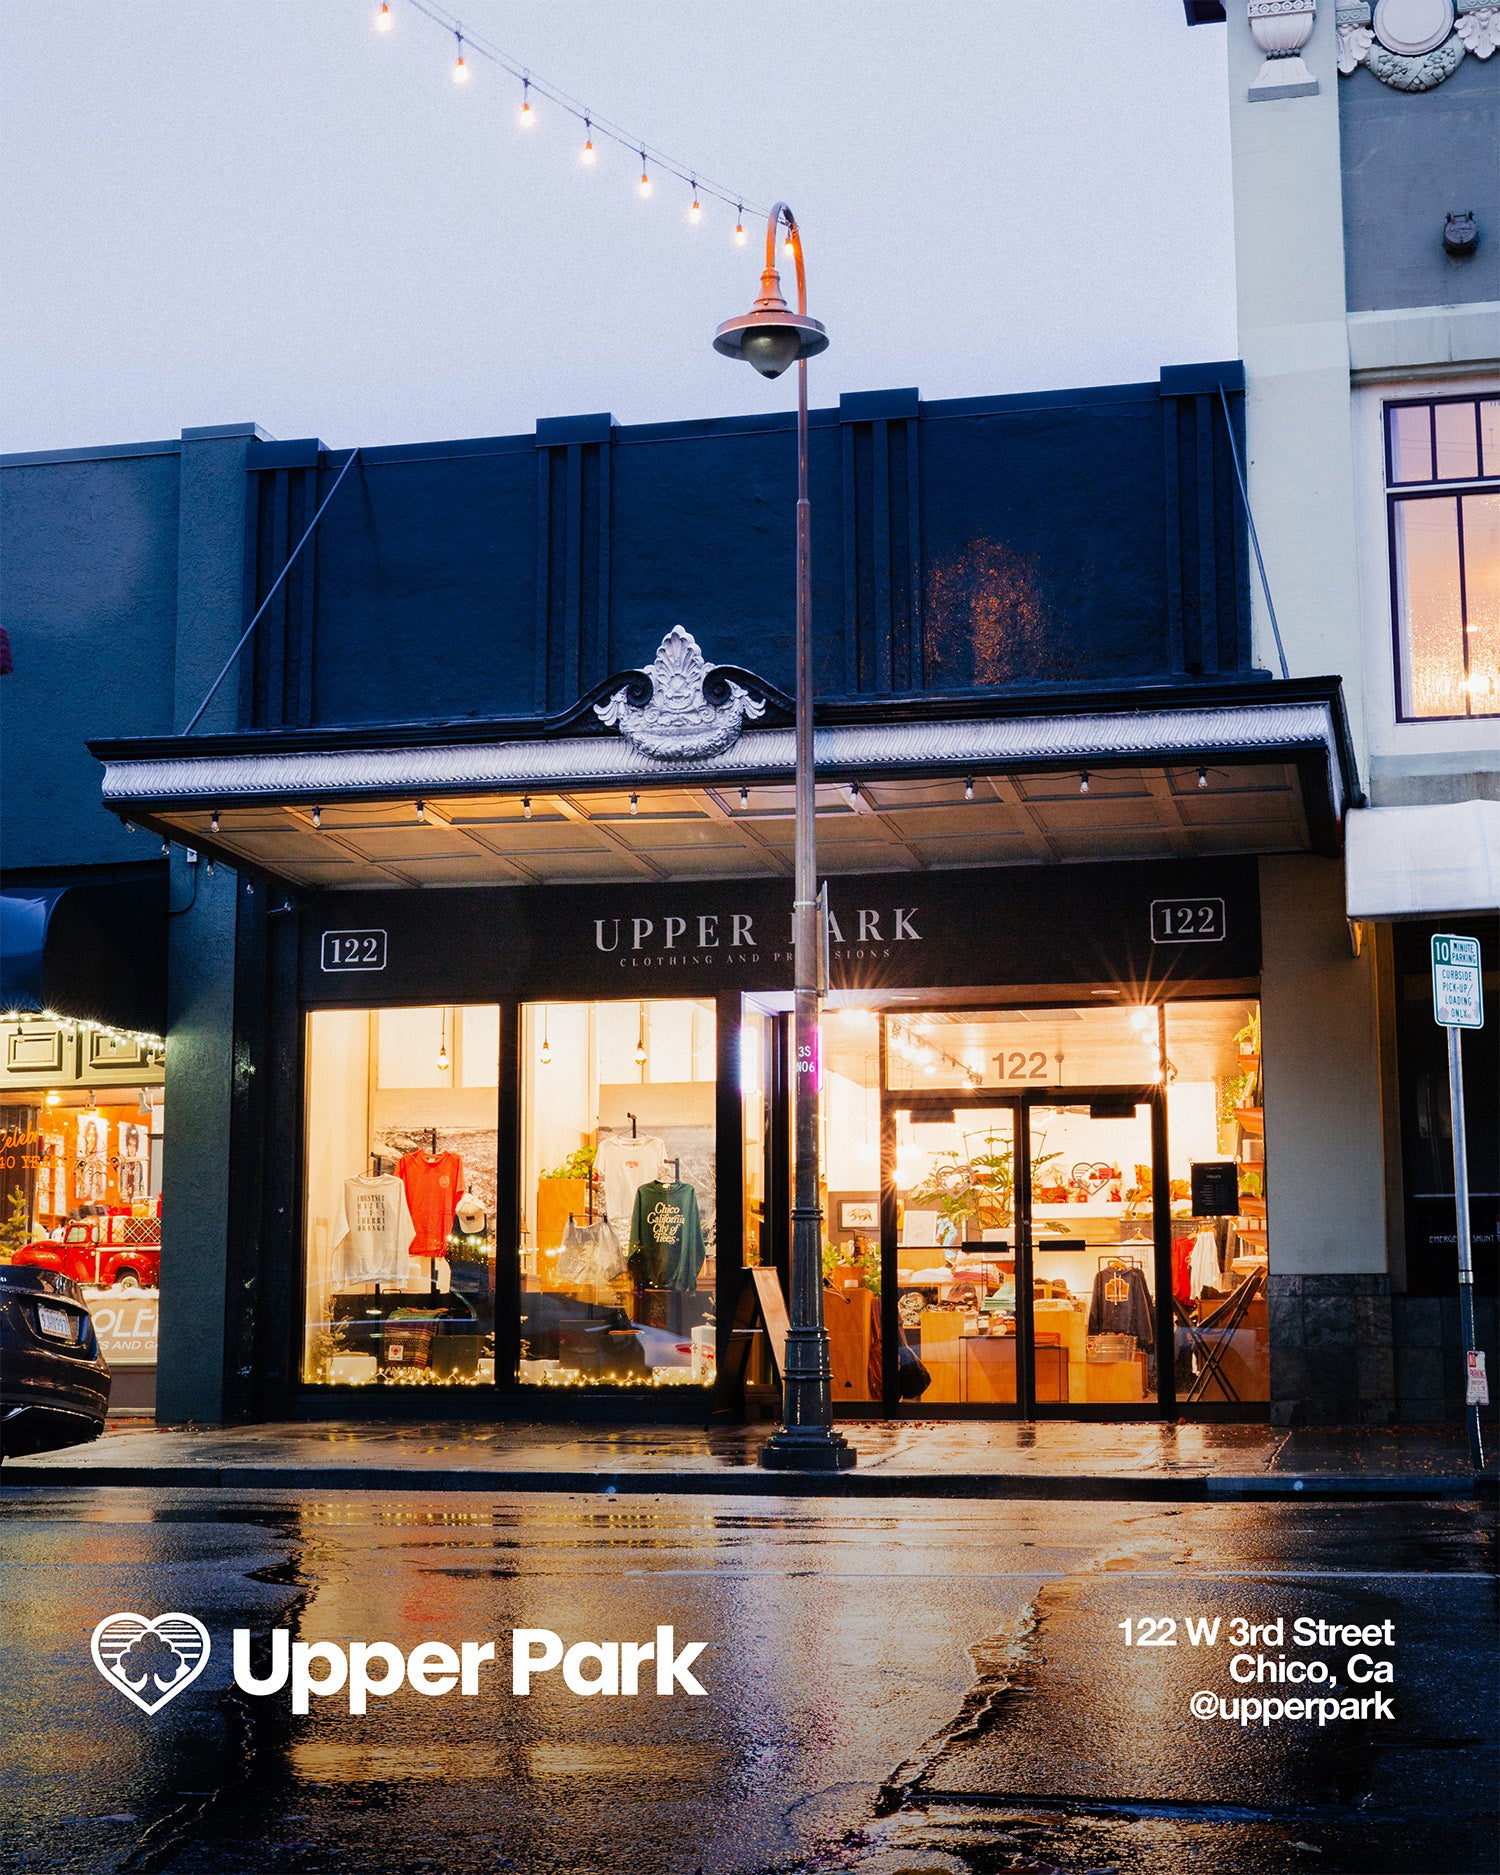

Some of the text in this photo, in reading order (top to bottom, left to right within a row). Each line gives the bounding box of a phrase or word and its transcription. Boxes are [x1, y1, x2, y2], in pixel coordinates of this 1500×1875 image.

[1161, 906, 1215, 934] 122
[593, 914, 757, 951] UPPER
[331, 937, 378, 963] 122
[1435, 941, 1449, 961] 10
[1453, 943, 1474, 953] MINUTE
[619, 954, 713, 967] CLOTHING
[725, 953, 760, 964] AND
[1452, 952, 1476, 964] PARKING
[1441, 969, 1472, 981] CURBSIDE
[1445, 995, 1472, 1007] LOADING
[1450, 1008, 1467, 1018] ONLY
[798, 1045, 811, 1058] 3S
[992, 1051, 1047, 1079] 122
[655, 1202, 680, 1214] Chico
[647, 1212, 685, 1225] California
[653, 1223, 681, 1236] City of
[112, 1341, 141, 1350] AND
